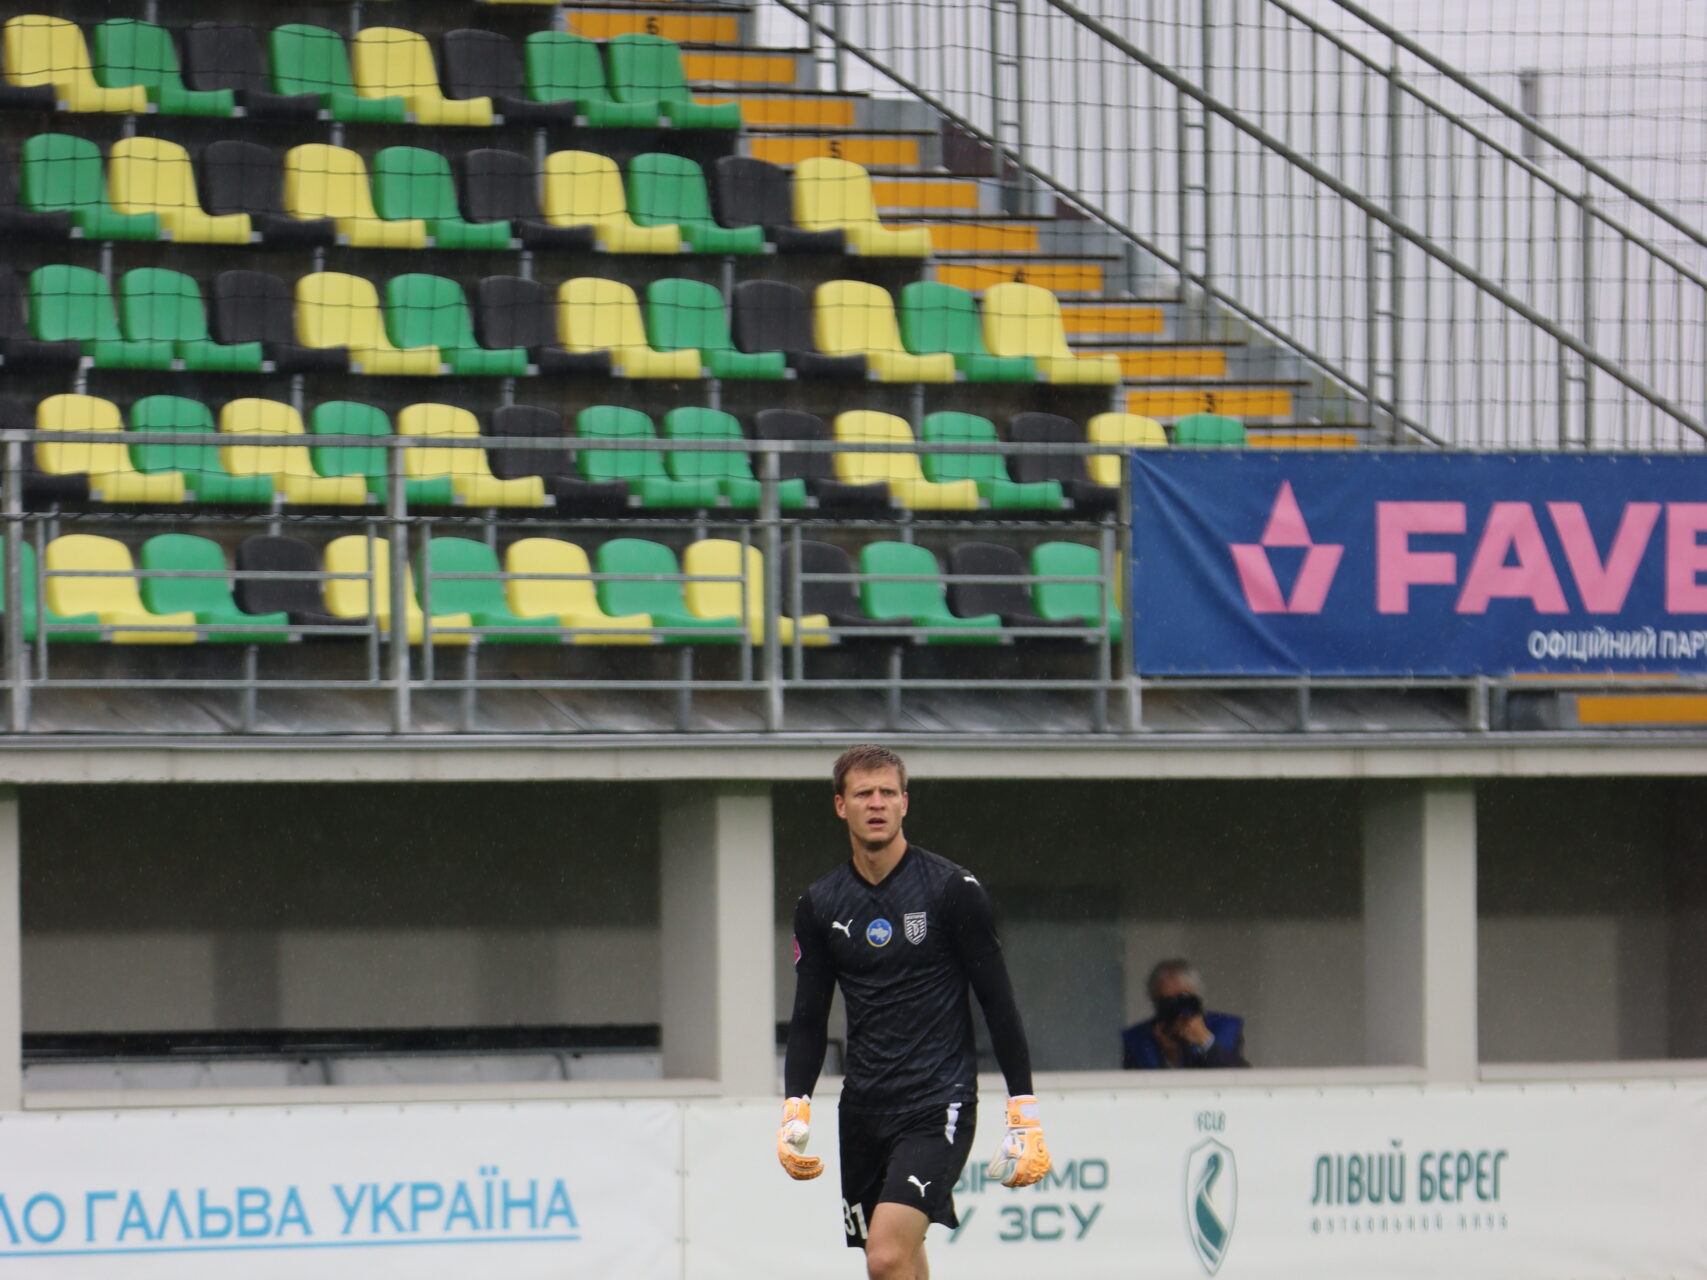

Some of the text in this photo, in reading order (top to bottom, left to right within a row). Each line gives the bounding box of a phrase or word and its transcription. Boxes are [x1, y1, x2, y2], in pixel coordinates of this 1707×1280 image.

[1527, 625, 1707, 663] ОФІЦІЙНИЙ ПАР
[952, 1159, 1109, 1194] ІРМО
[1310, 1139, 1509, 1206] ЛІВИЙ БЕРЕГ
[84, 1185, 314, 1243] ГАЛЬВА
[331, 1165, 580, 1236] УКРАЇНА
[998, 1203, 1104, 1243] ЗСУ
